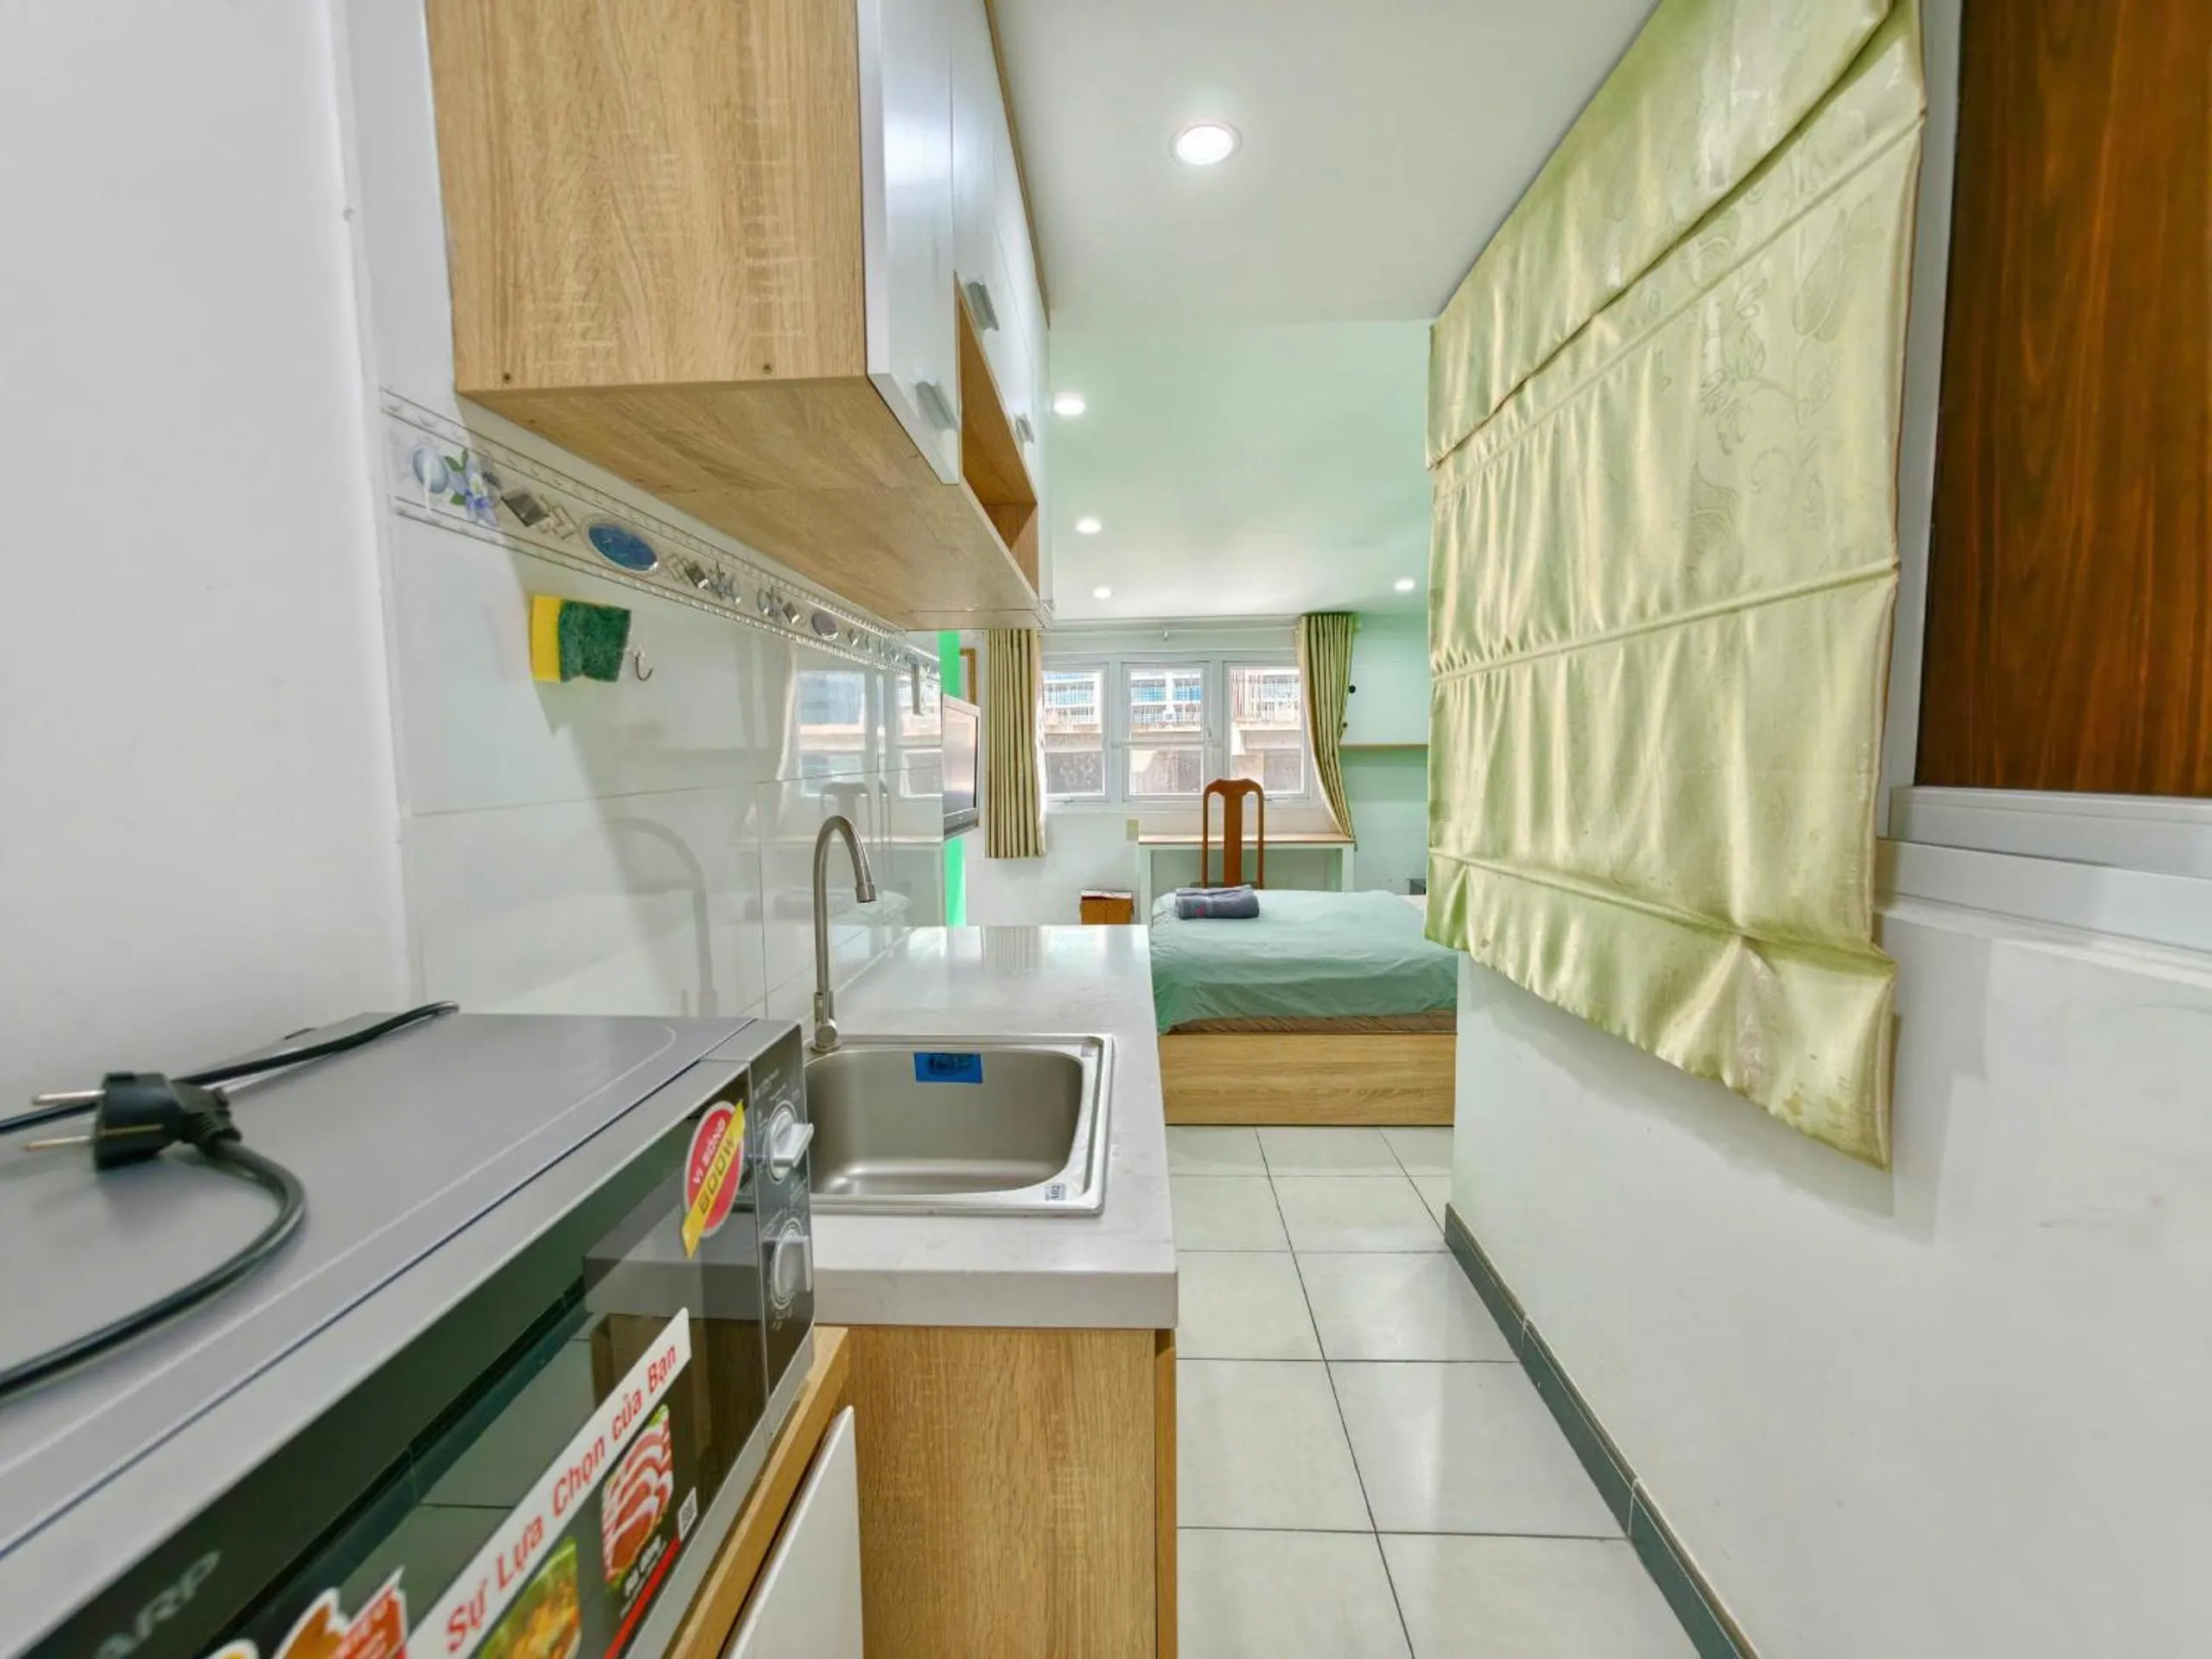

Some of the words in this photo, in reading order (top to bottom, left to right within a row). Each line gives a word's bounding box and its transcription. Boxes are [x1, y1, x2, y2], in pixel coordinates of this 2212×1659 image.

[447, 1578, 488, 1653] Sự
[496, 1515, 543, 1591] Lựa
[552, 1434, 605, 1517] Chọn
[612, 1388, 643, 1442] của
[649, 1344, 677, 1394] Bạn
